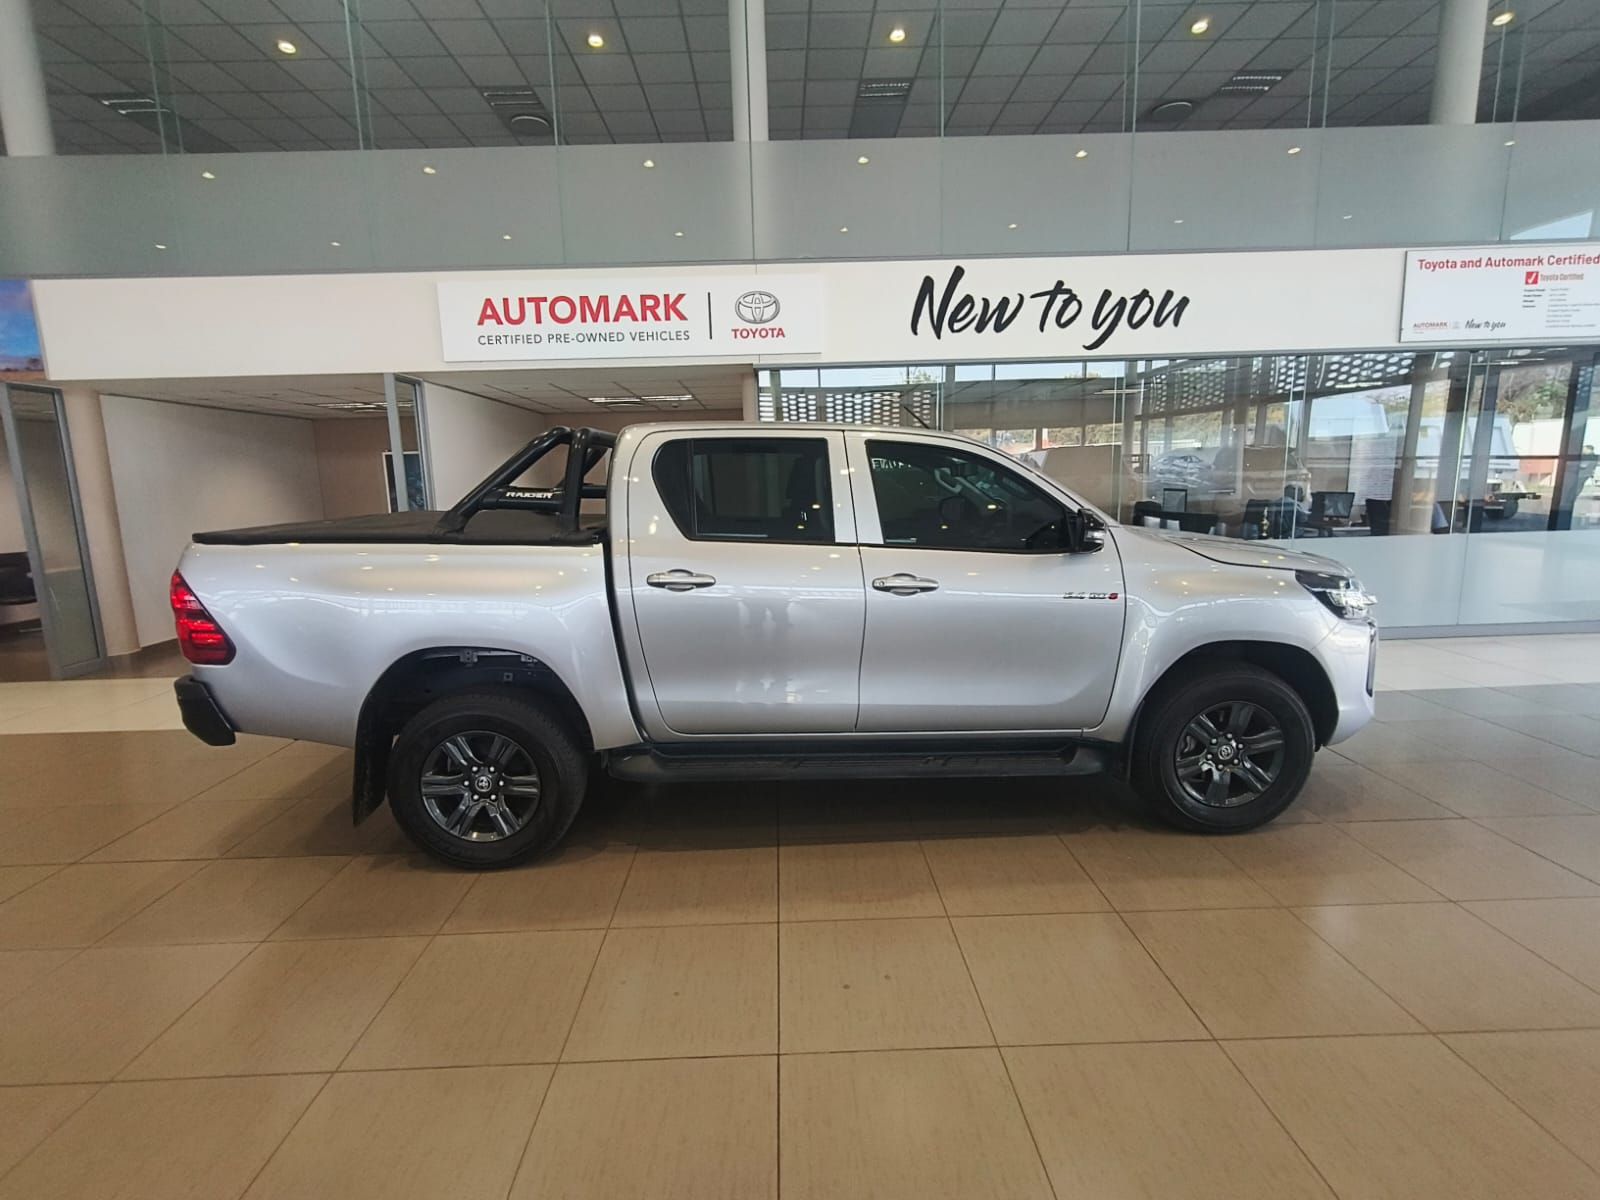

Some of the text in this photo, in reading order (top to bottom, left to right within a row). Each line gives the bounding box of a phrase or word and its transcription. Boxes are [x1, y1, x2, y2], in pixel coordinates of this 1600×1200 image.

[1417, 253, 1600, 272] Toyota and Automark Certified
[477, 293, 688, 326] AUTOMARK
[911, 265, 1190, 351] New to you
[1413, 321, 1448, 329] AUTOMARK
[1464, 318, 1482, 329] New
[477, 330, 690, 345] CERTIFIED PRE-OWNED VEHICLES
[731, 327, 786, 339] TOYOTA
